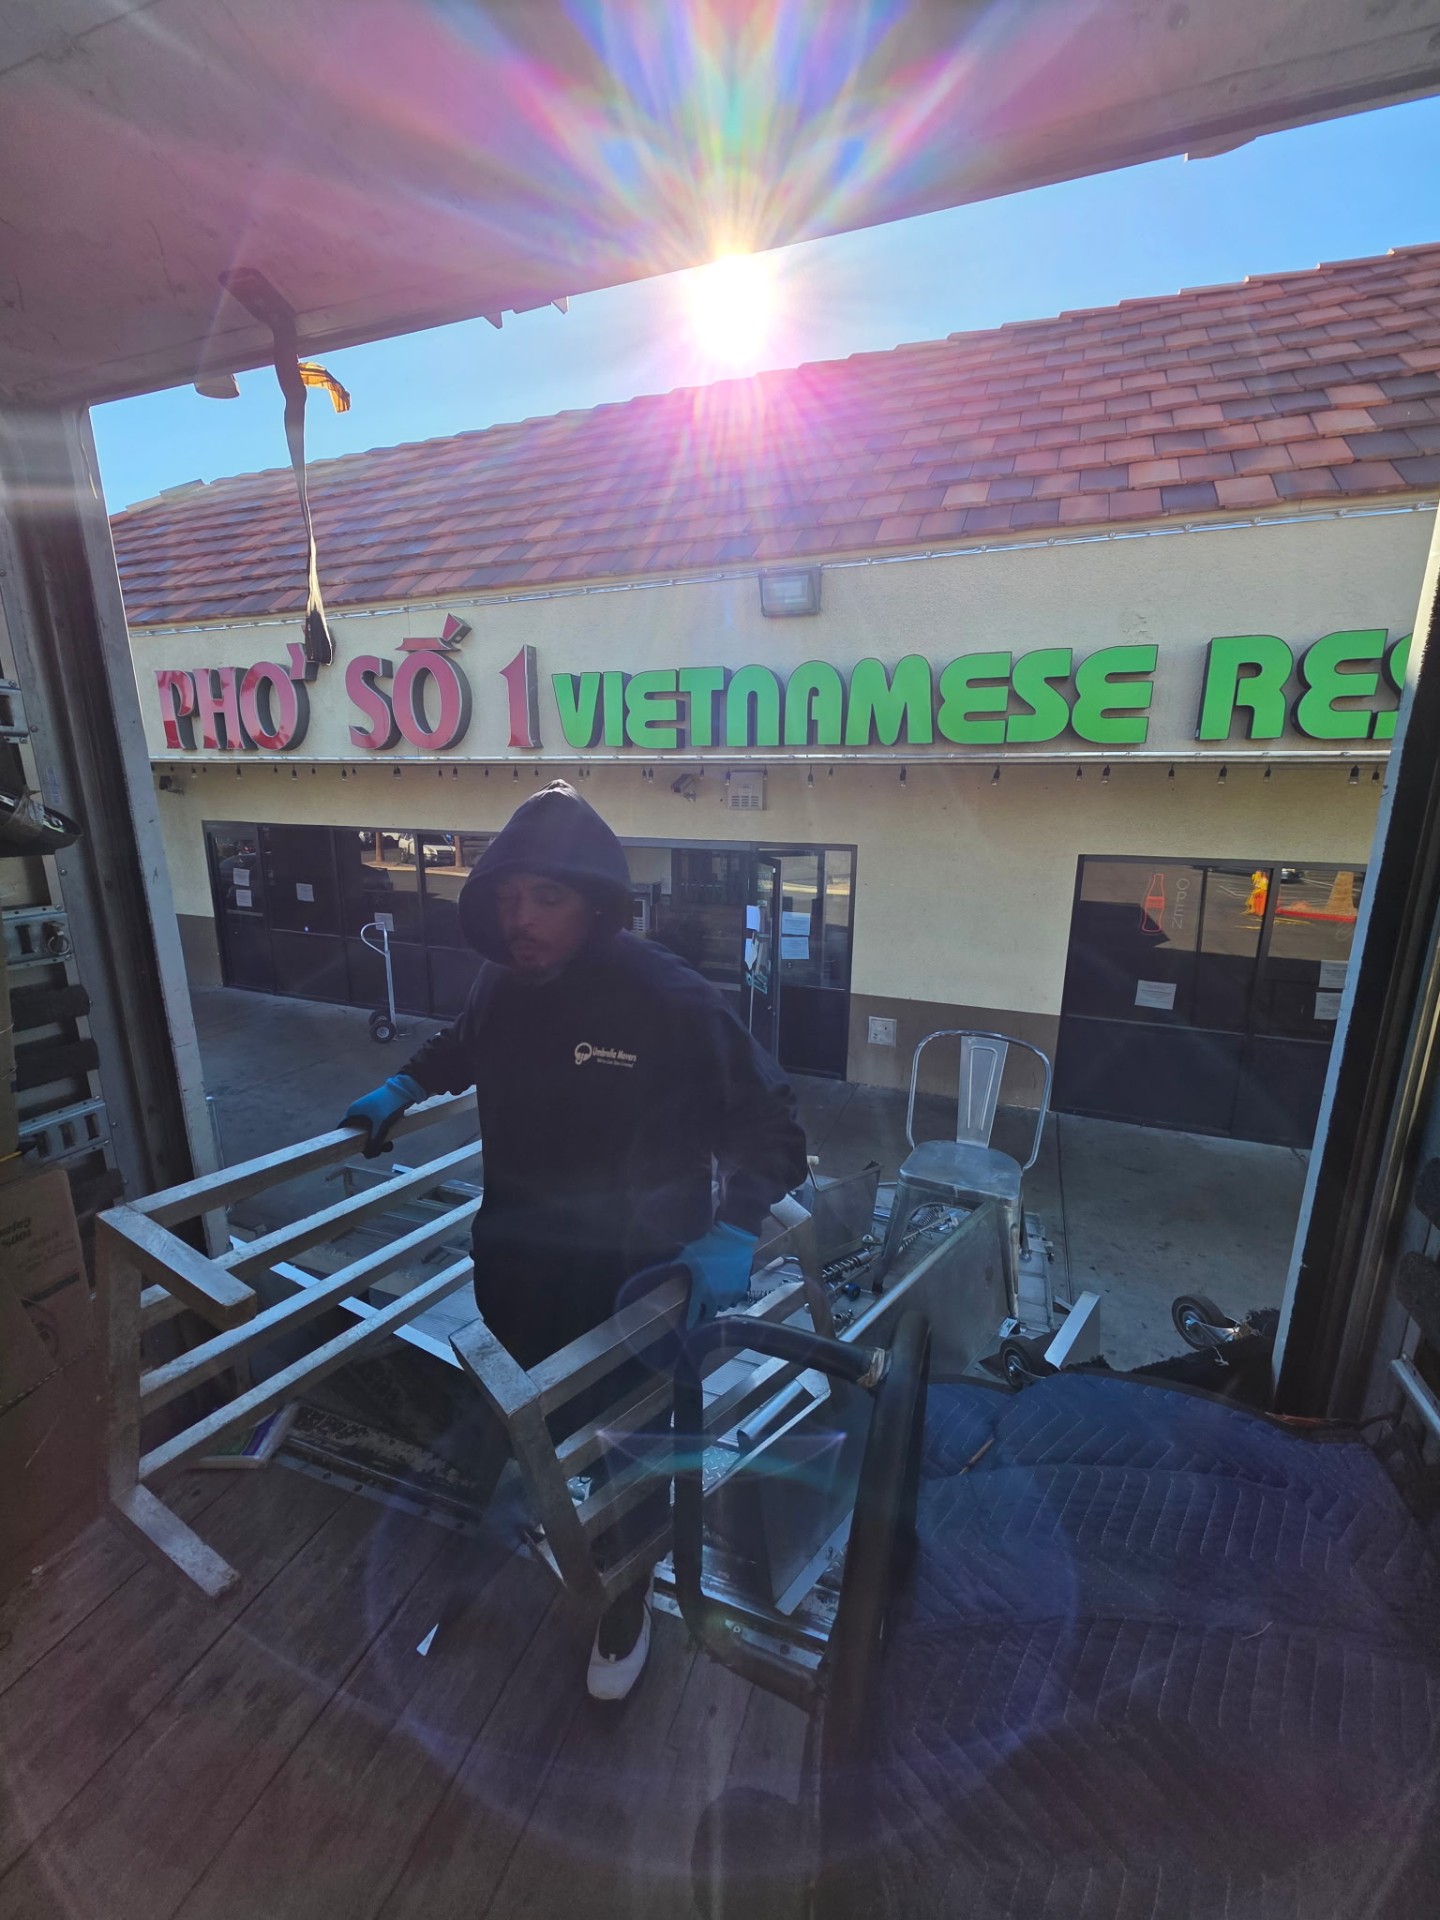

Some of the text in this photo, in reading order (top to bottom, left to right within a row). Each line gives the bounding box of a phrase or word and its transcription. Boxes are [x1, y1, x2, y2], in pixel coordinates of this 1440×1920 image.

[499, 644, 544, 749] 1
[552, 644, 1159, 749] VIETNAMESE
[1171, 877, 1191, 930] OPEN
